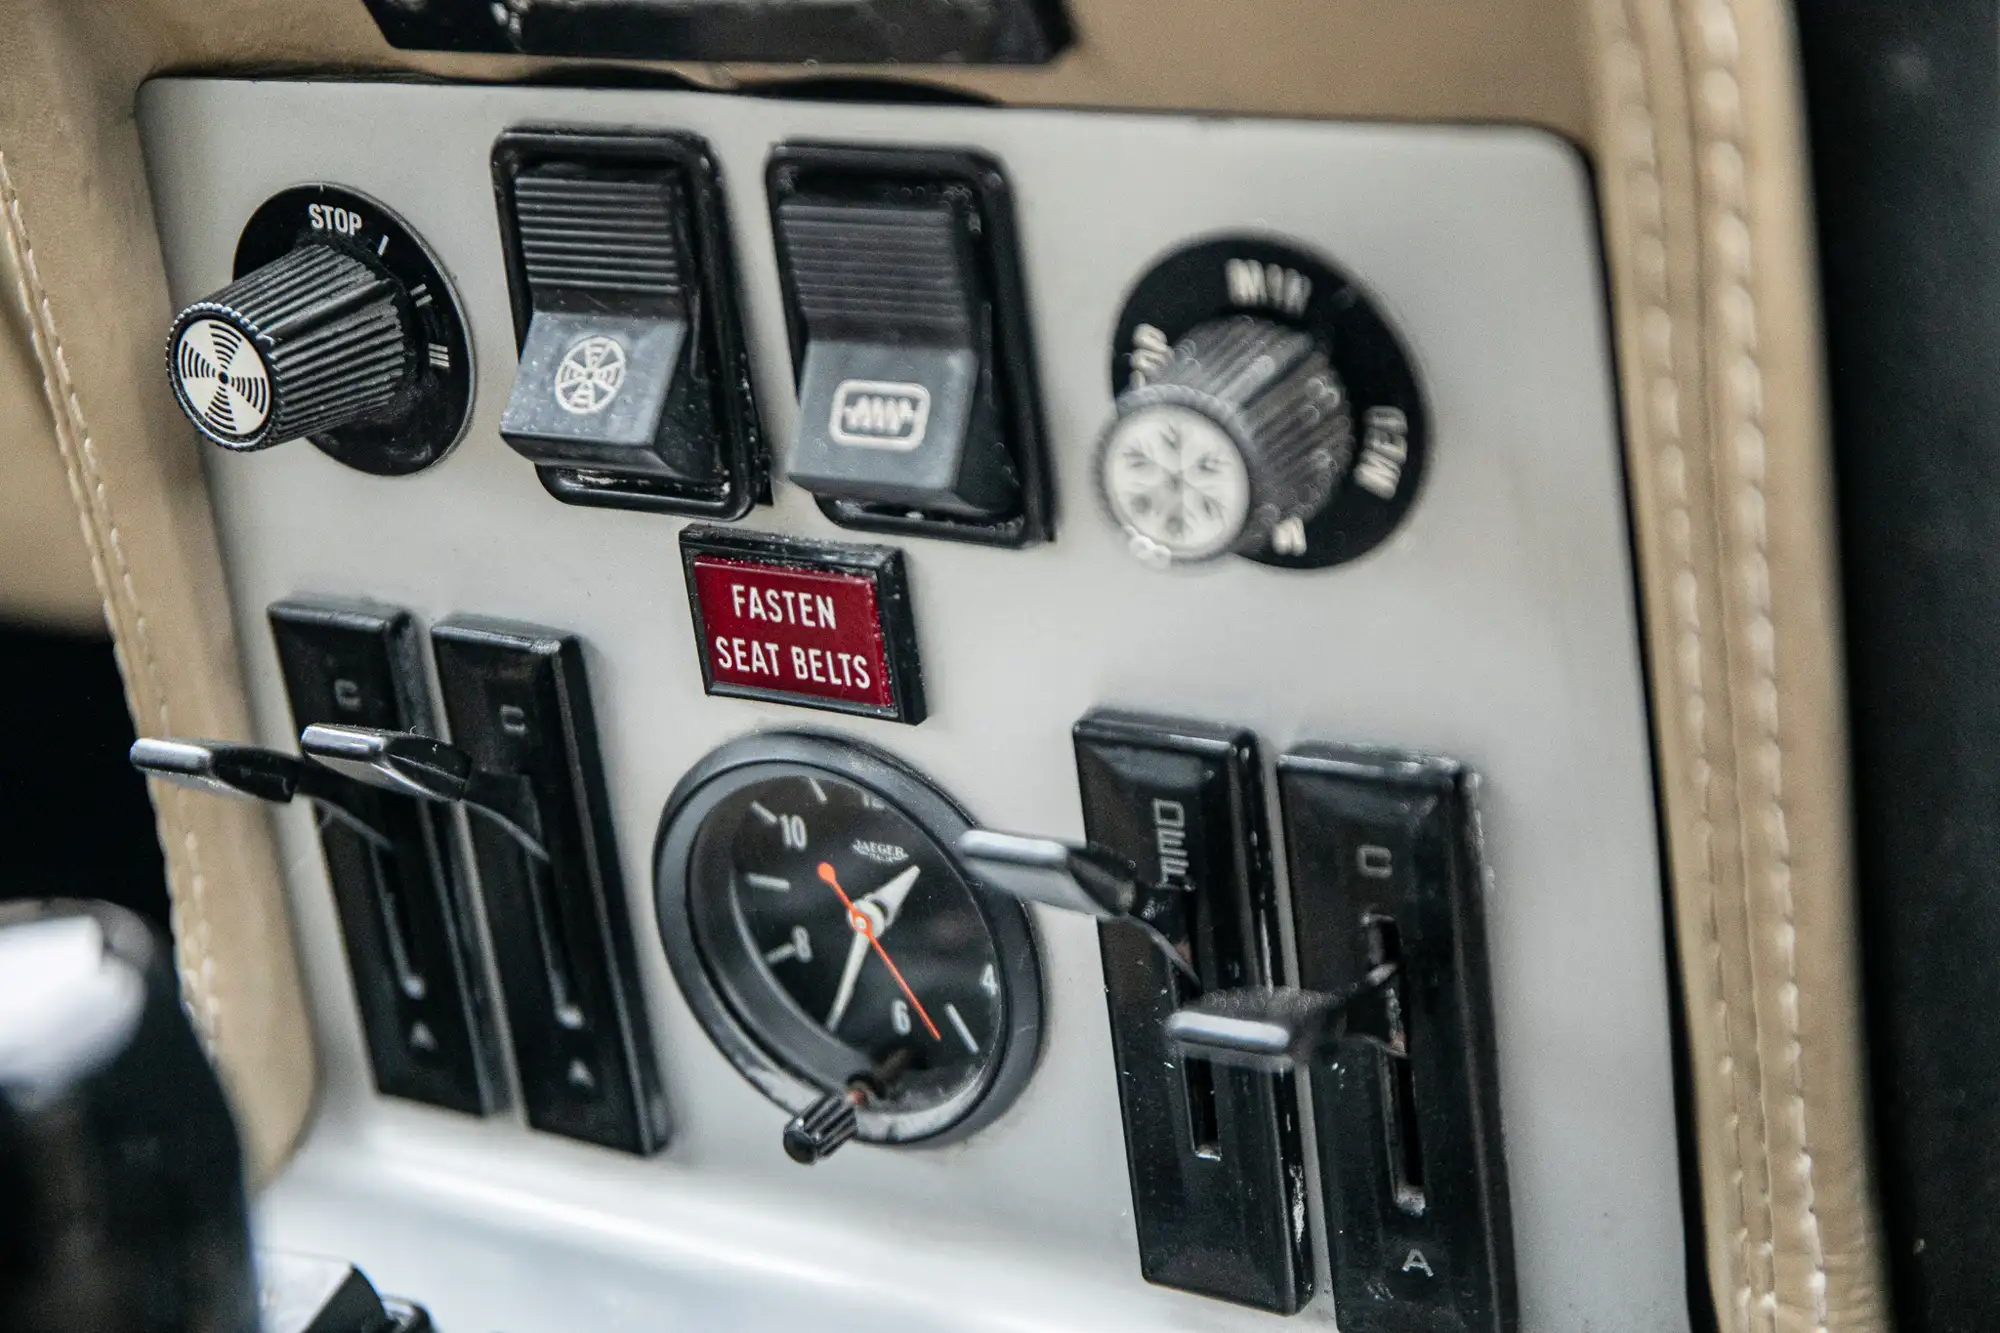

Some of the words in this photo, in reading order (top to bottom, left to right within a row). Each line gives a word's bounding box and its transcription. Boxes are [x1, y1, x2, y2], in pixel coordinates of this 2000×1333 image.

[308, 203, 362, 236] STOP
[731, 583, 837, 630] FASTEN
[715, 636, 780, 677] SEAT
[790, 645, 871, 690] BELTS
[780, 814, 807, 850] 10
[852, 838, 905, 859] JAEGER
[792, 925, 813, 963] 8
[979, 962, 998, 996] 4
[891, 998, 912, 1036] 6
[1402, 1248, 1434, 1277] A
